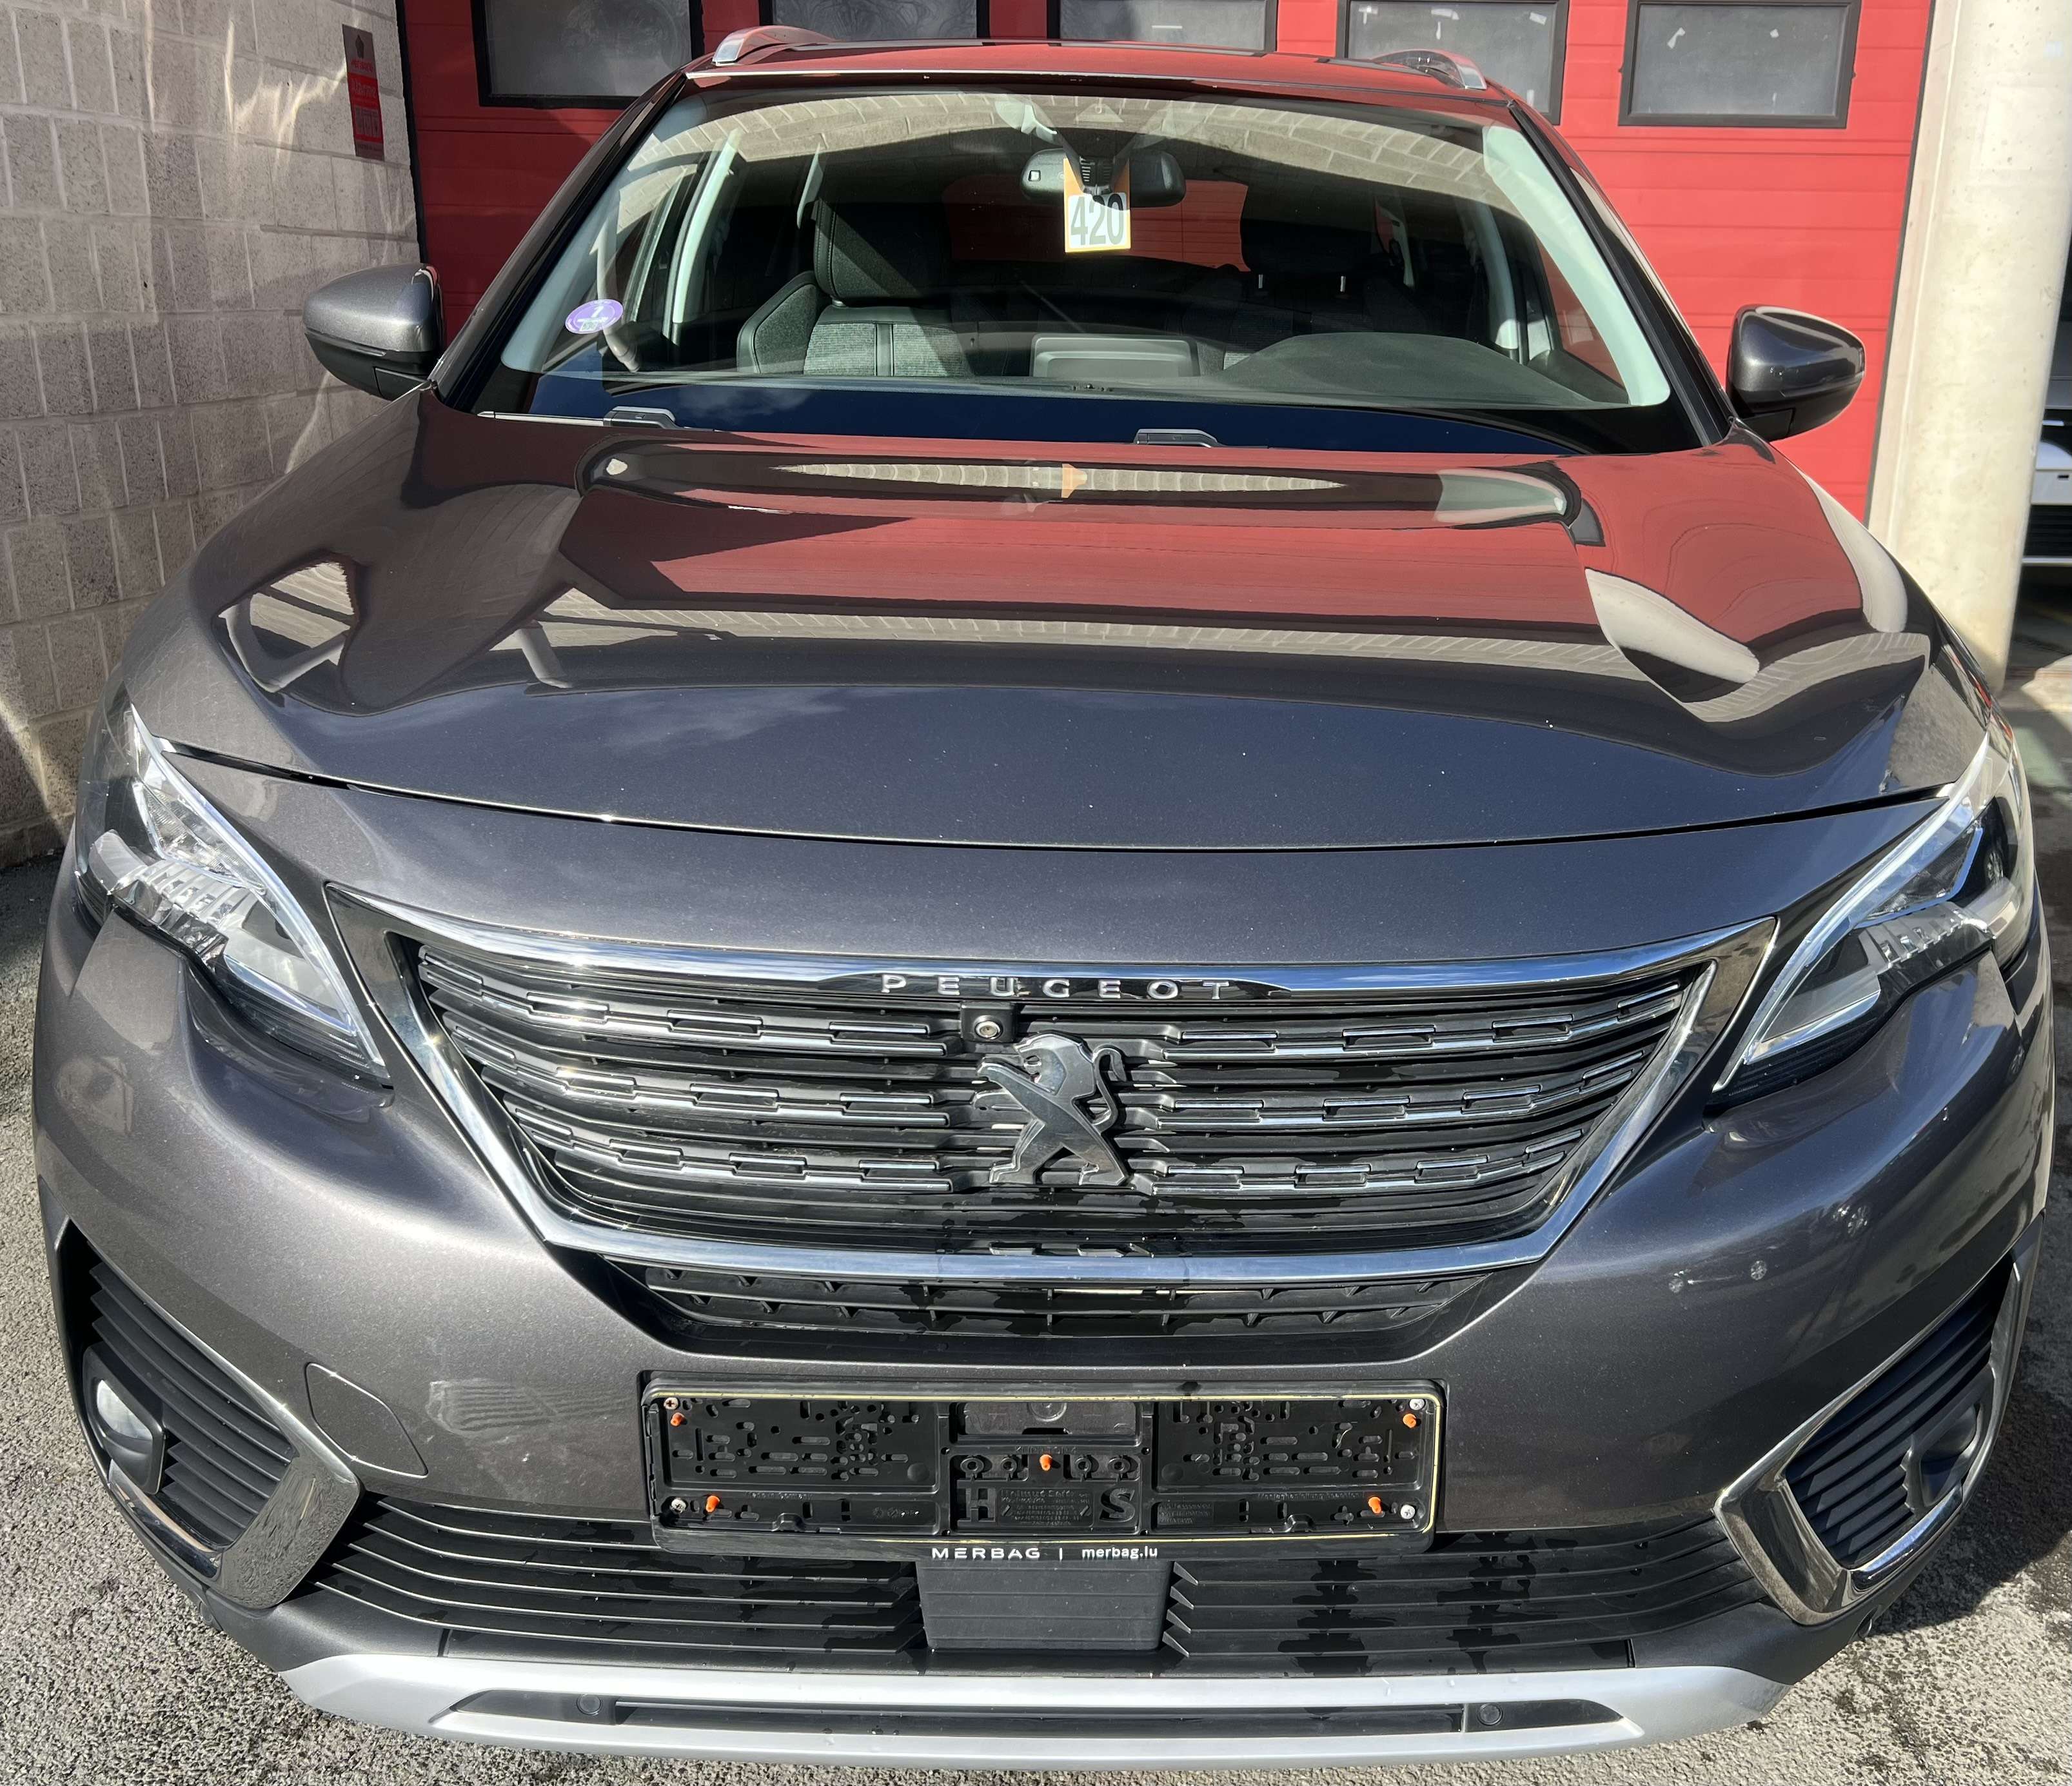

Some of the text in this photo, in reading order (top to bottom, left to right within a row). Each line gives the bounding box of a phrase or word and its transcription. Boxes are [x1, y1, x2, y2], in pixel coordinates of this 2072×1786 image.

[1071, 193, 1124, 245] 420
[881, 974, 1229, 1000] PEUGEOT
[932, 1547, 1041, 1560] MERBAG
[1081, 1545, 1158, 1560] merbag.lu
